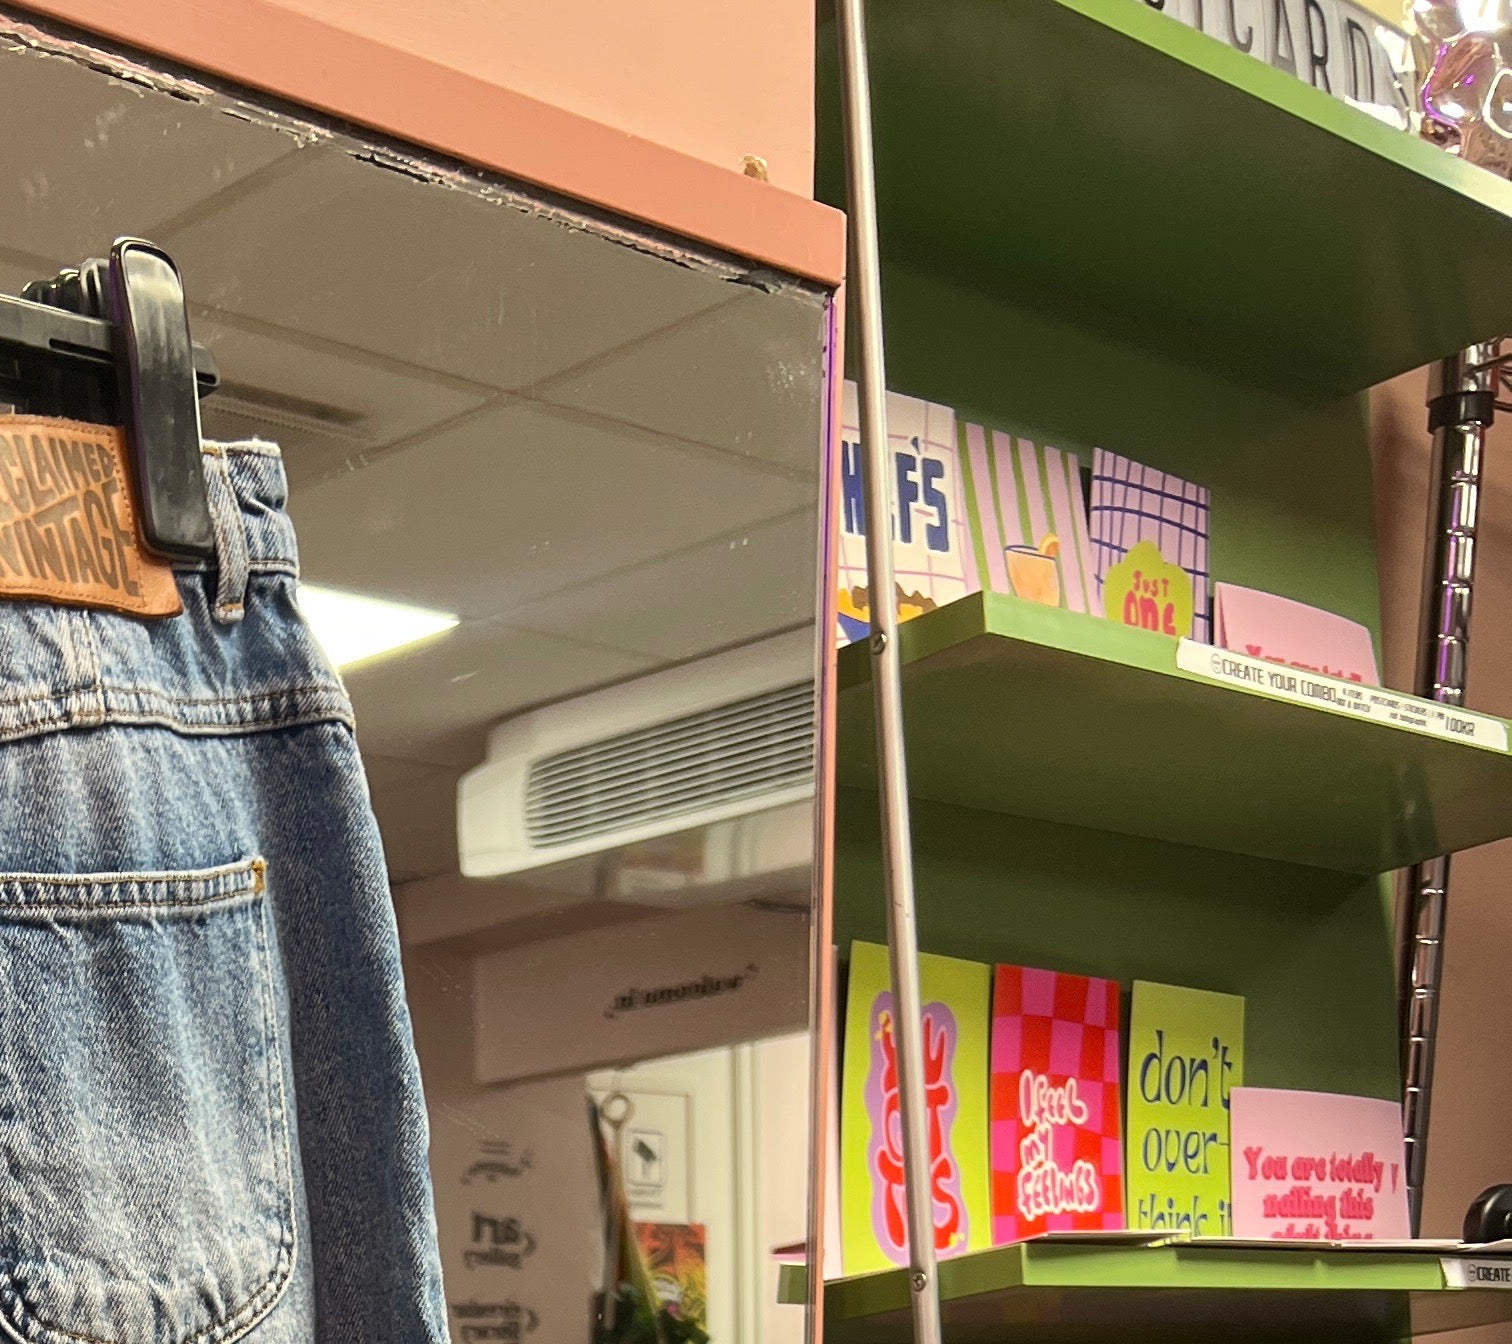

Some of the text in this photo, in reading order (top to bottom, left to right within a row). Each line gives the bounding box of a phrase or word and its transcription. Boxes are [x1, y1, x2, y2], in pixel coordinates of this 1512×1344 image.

[1222, 659, 1265, 685] CREATE
[1268, 672, 1298, 694] YOUR
[1140, 1030, 1233, 1110] don't
[1243, 1147, 1384, 1193] You are totally
[1339, 1188, 1374, 1220] this
[1477, 1266, 1510, 1282] CREATE
